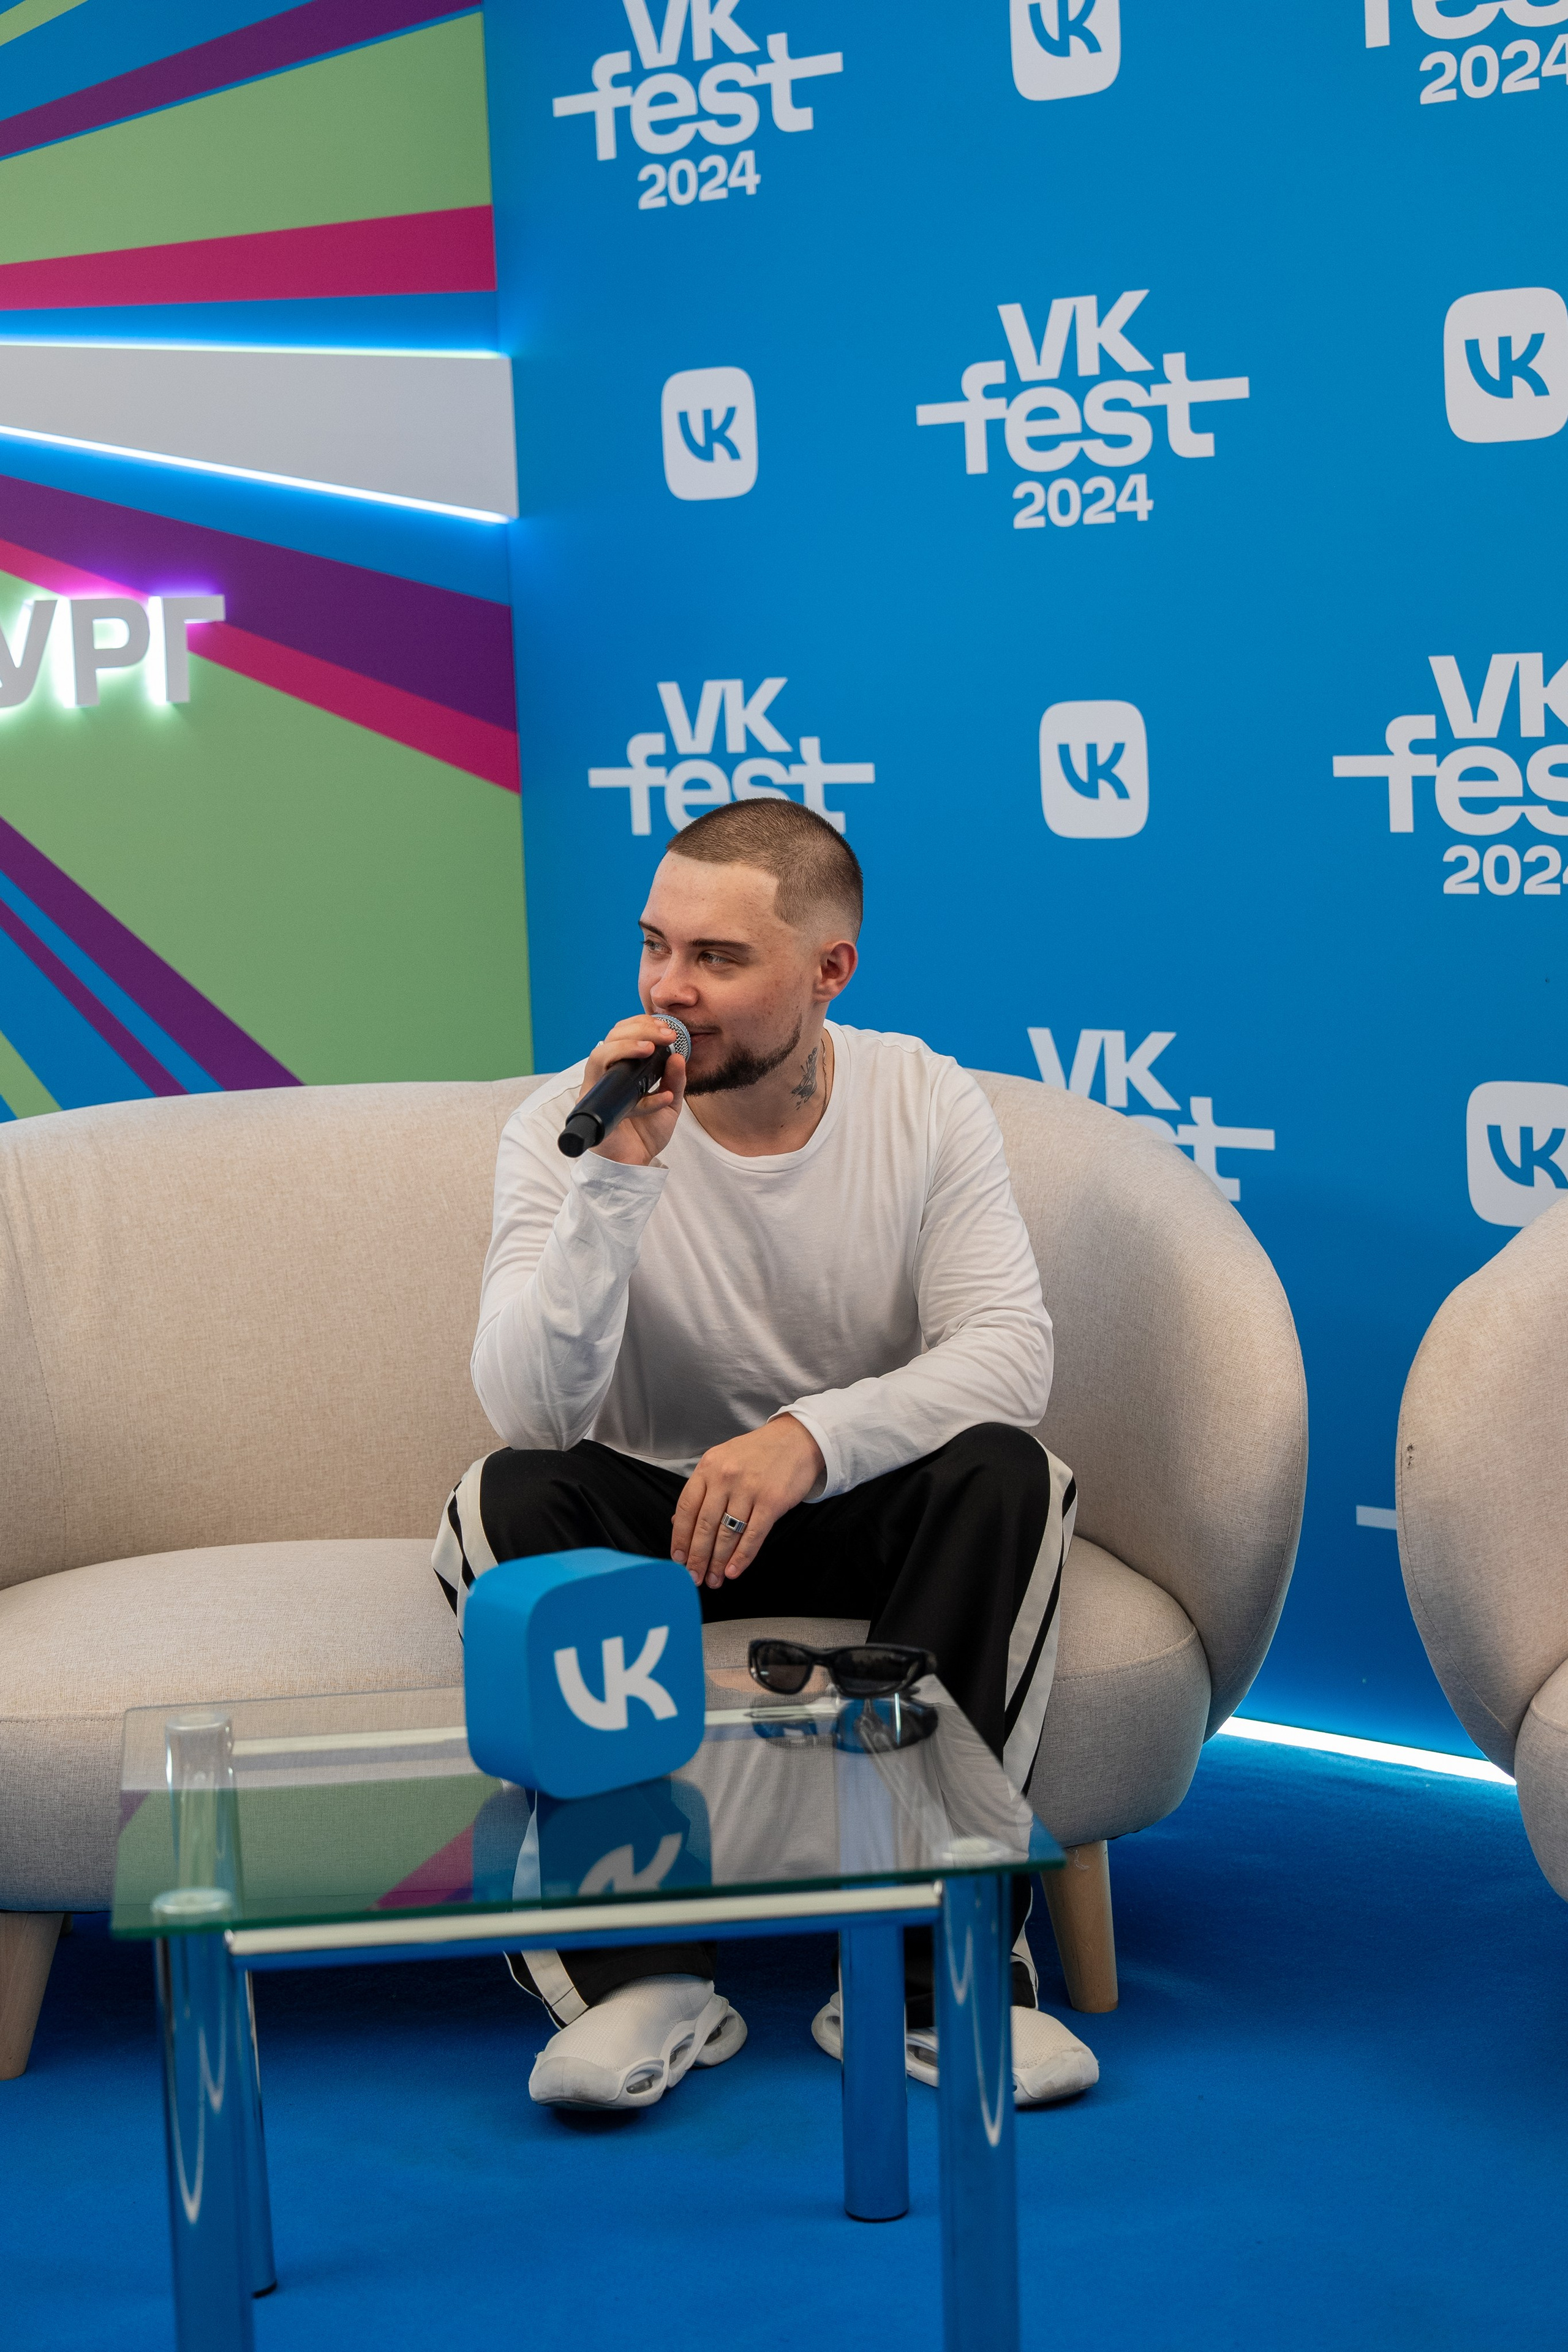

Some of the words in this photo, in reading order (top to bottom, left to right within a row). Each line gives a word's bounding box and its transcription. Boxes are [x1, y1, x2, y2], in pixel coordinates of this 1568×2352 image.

[624, 0, 760, 69] VK
[1029, 0, 1102, 58] VK
[553, 32, 843, 161] fest
[638, 150, 761, 209] 2024
[997, 289, 1154, 382] VK
[1464, 333, 1550, 399] VK
[678, 406, 741, 462] VK
[916, 352, 1250, 475] fest
[1012, 473, 1154, 529] 2024
[657, 677, 792, 754] VK
[1058, 742, 1130, 800] VK
[1442, 844, 1568, 895] 202
[1027, 1027, 1182, 1111] VK
[1487, 1124, 1568, 1189] VK
[554, 1626, 677, 1731] VK
